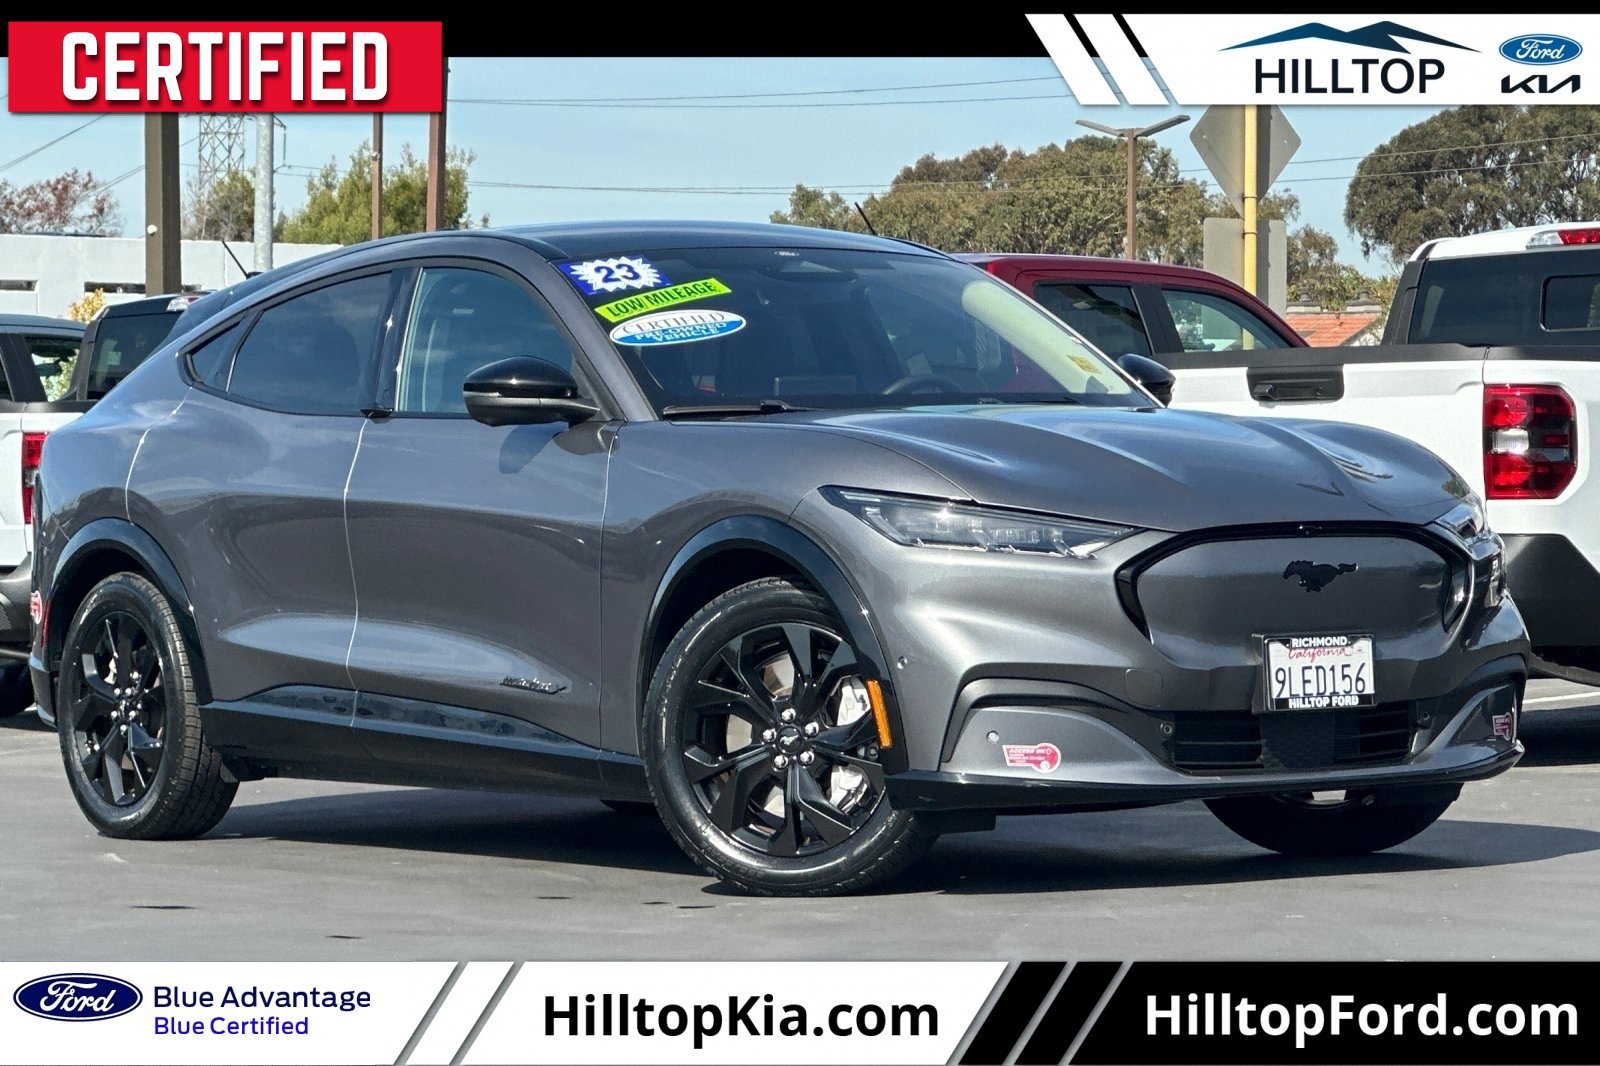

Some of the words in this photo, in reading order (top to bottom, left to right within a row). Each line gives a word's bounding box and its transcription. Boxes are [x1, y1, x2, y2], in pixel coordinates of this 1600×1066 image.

[594, 263, 642, 284] 23
[606, 298, 645, 318] LOW
[644, 281, 716, 306] MILEAGE
[622, 312, 725, 335] CERTIFIED
[634, 321, 728, 341] PRE-OWNED
[652, 327, 720, 343] VEHICLE
[1291, 635, 1348, 648] RICHMOND
[1288, 646, 1353, 663] California
[1274, 662, 1366, 698] 9LED156
[1288, 696, 1330, 709] HILLTOP
[1331, 695, 1359, 706] FORD
